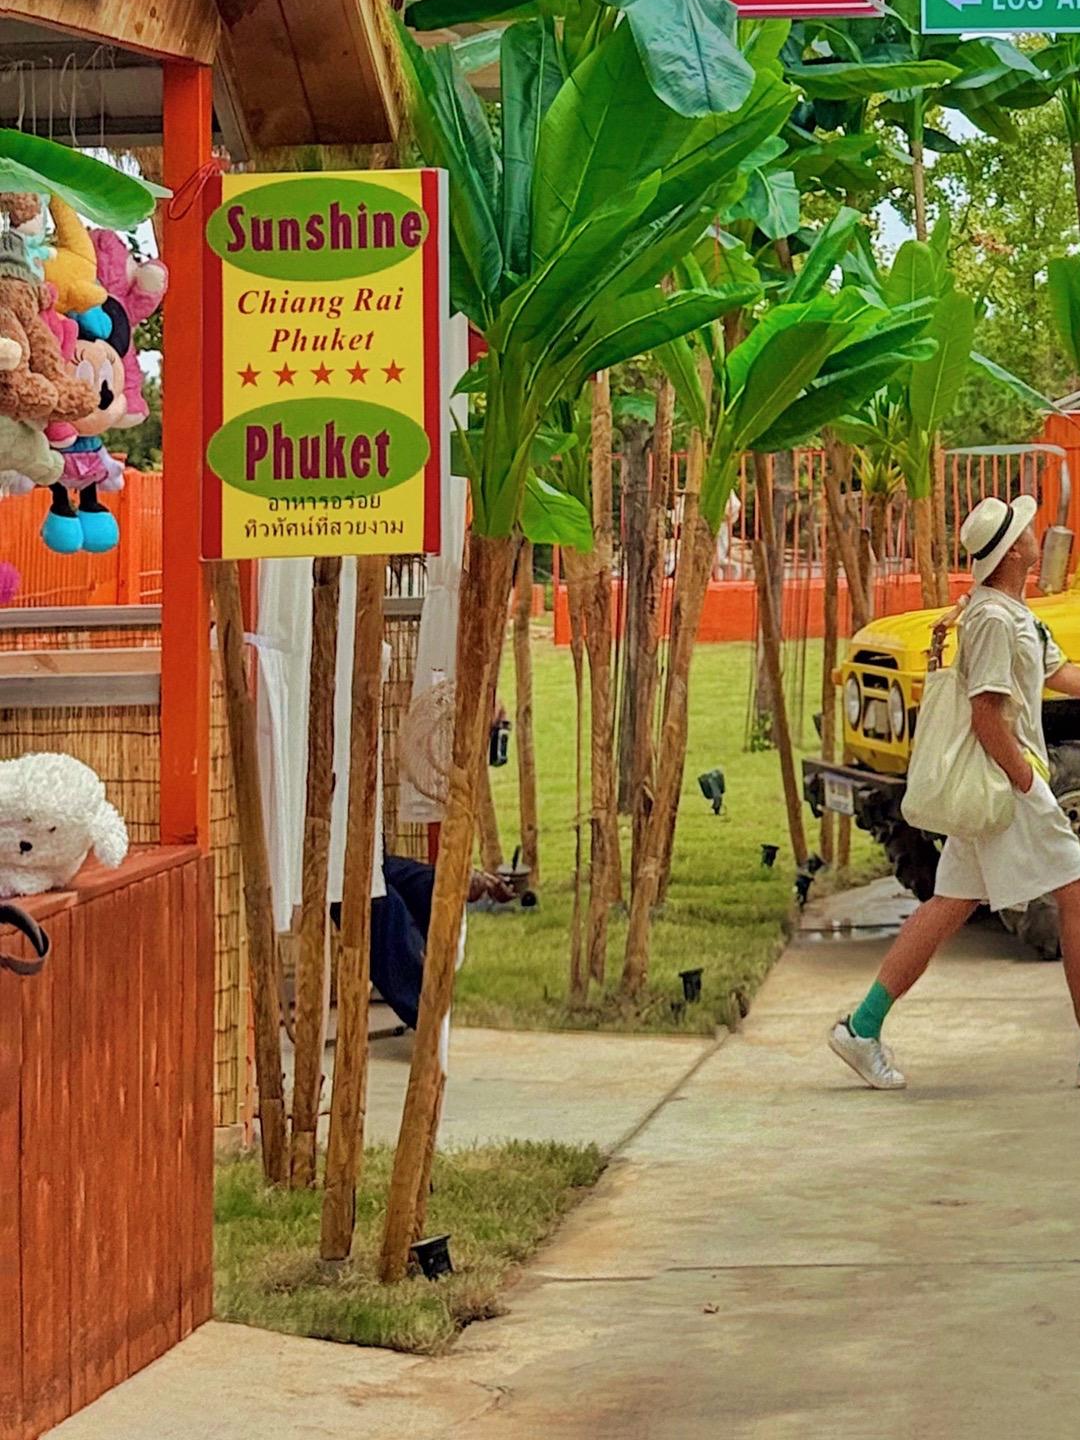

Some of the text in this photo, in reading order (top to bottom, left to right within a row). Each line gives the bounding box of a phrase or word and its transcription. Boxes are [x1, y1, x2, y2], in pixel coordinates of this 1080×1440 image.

[226, 201, 423, 253] Sunshine
[238, 286, 404, 319] Chiang Rai
[268, 328, 375, 353] Phuket
[245, 419, 391, 481] Phuket
